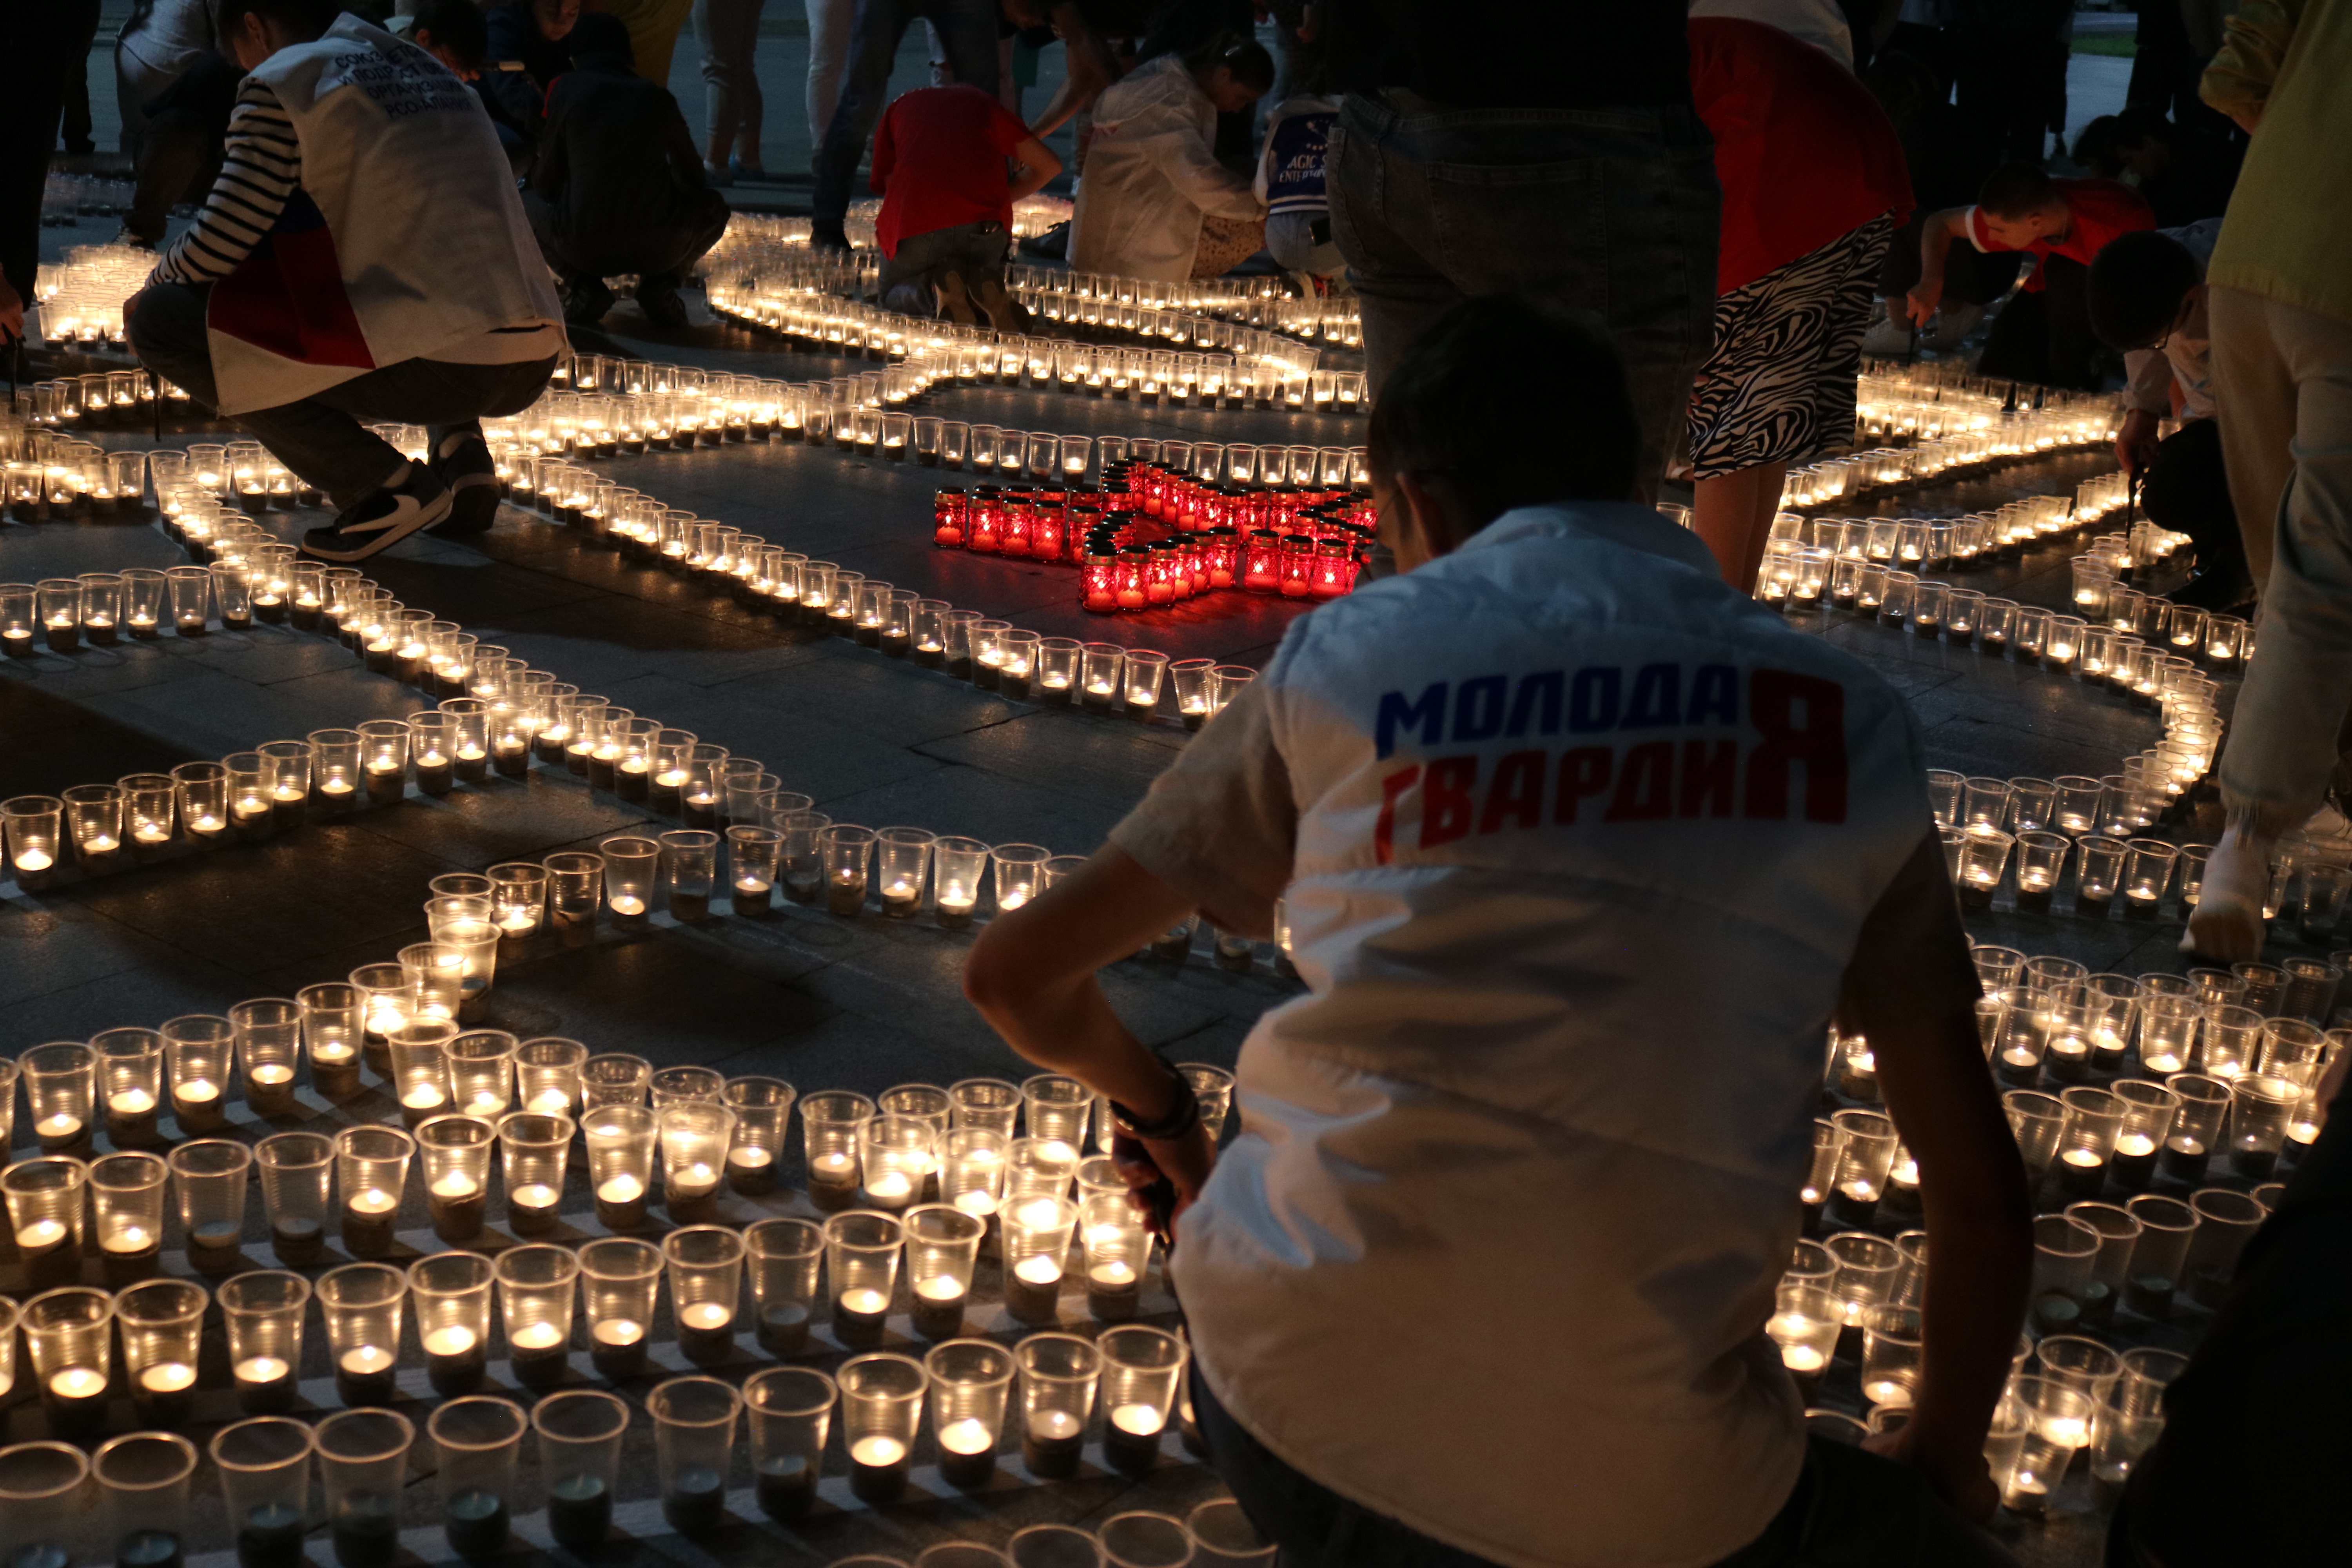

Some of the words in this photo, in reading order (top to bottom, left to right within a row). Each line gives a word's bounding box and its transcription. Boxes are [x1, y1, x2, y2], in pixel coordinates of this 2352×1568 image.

[335, 51, 384, 68] СОЮЗ
[1287, 154, 1318, 169] AGIC
[1376, 668, 1847, 863] ГВАРДИЯ
